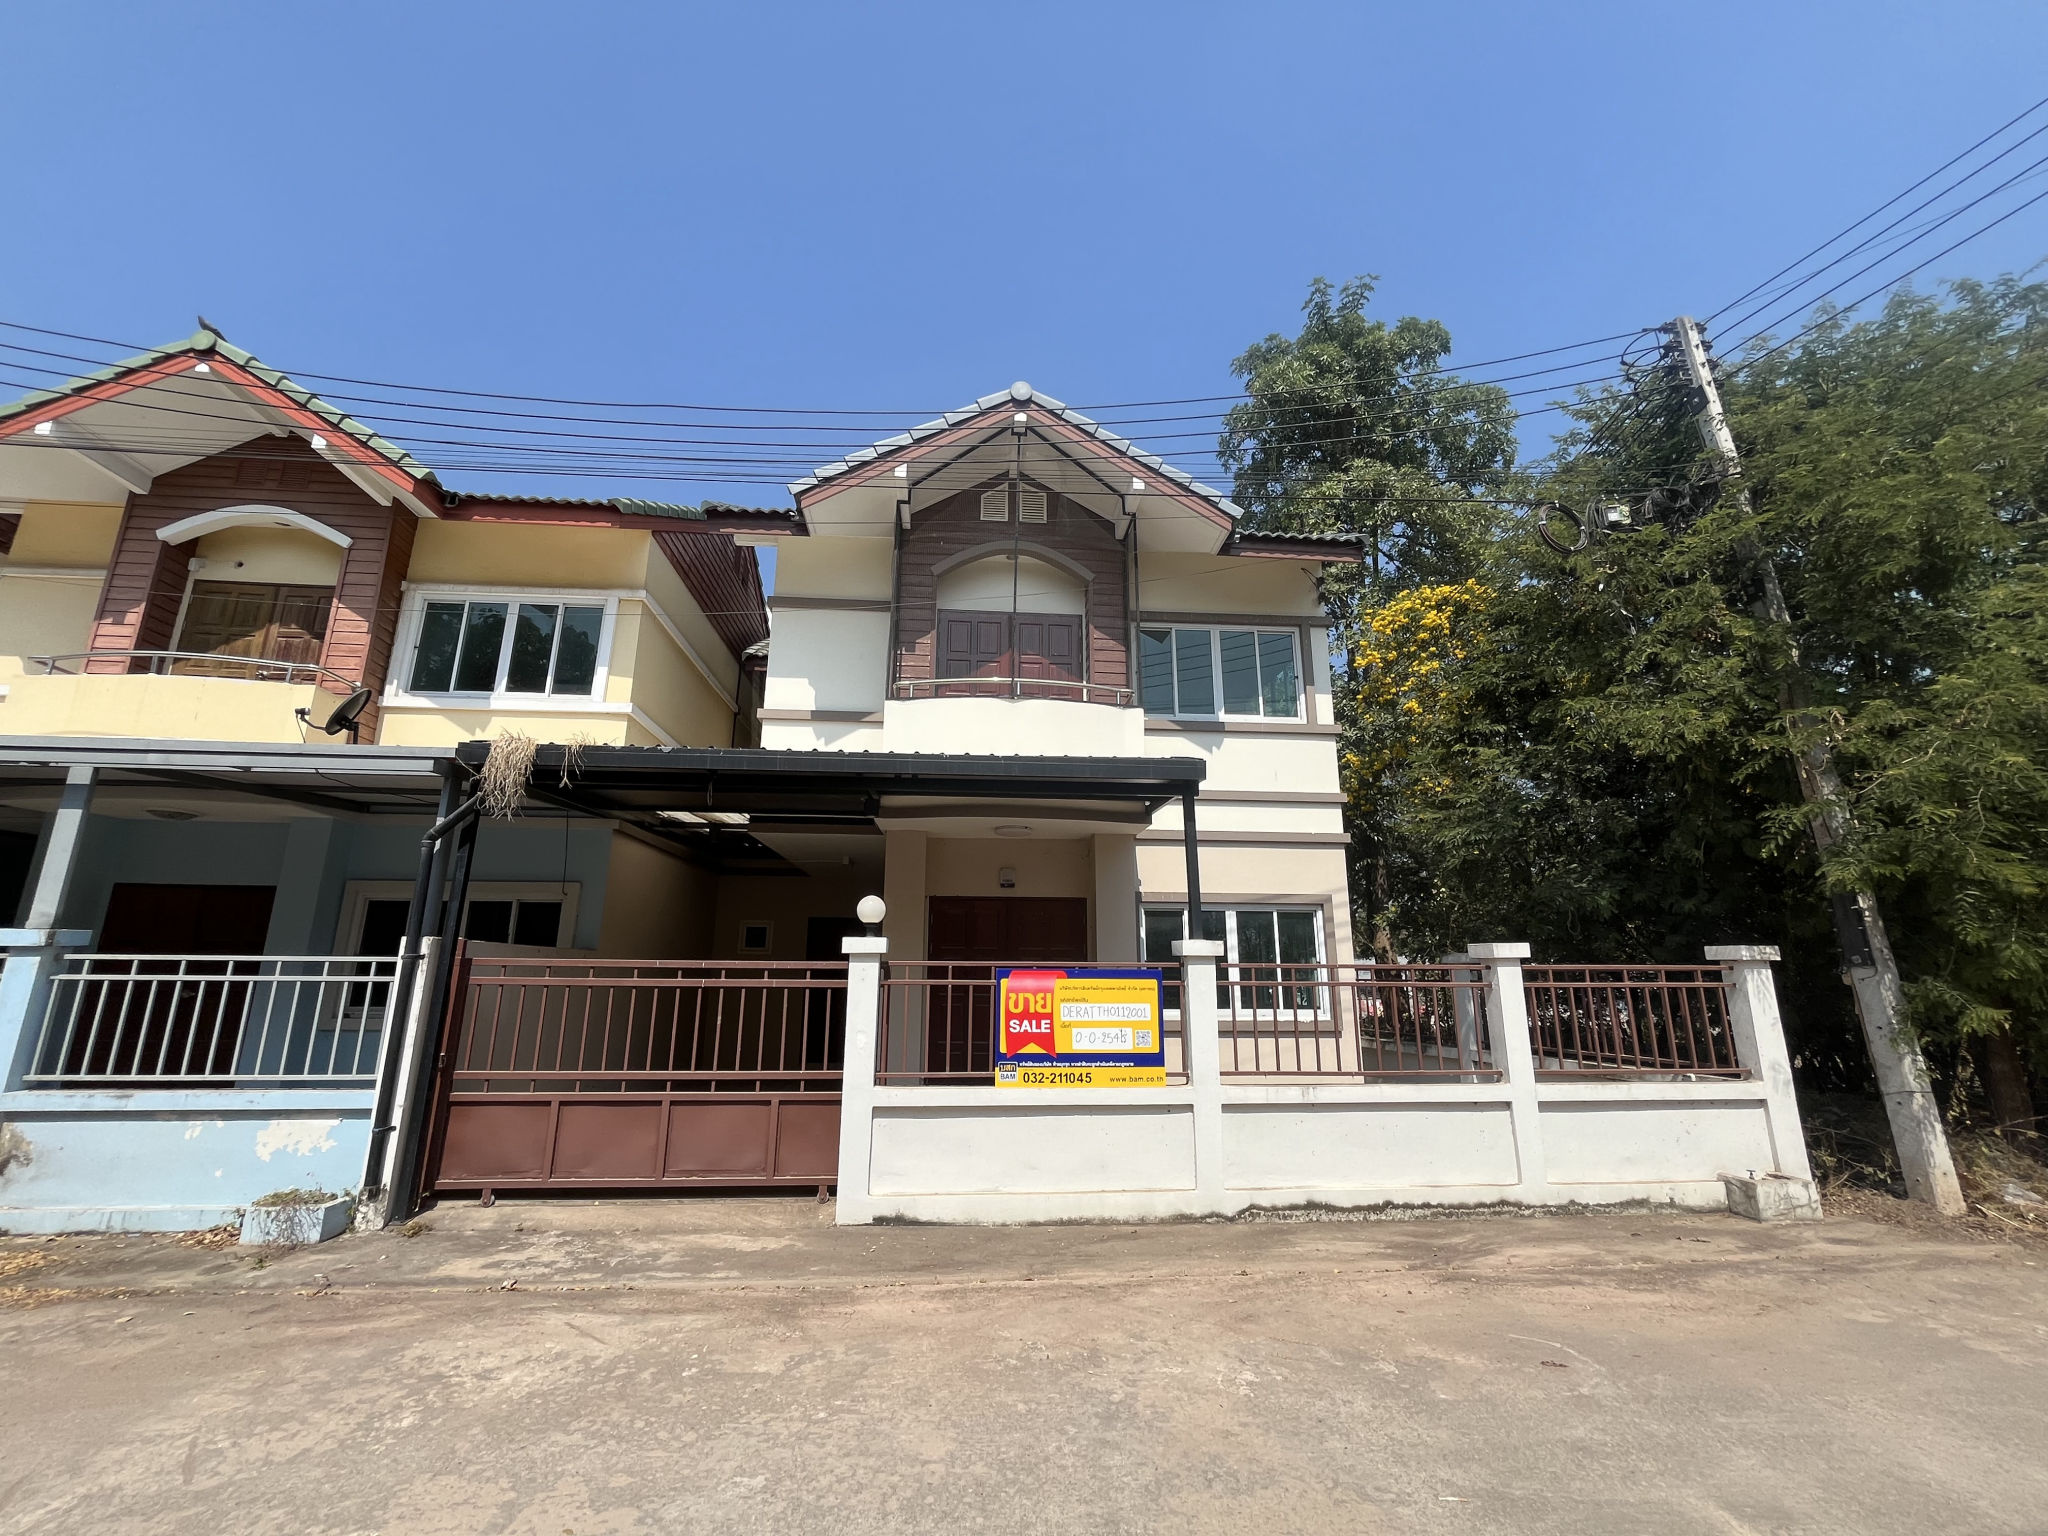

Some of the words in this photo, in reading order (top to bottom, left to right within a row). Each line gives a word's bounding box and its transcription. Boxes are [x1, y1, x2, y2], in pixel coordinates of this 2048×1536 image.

[1009, 992, 1052, 1014] ขาย
[1009, 1019, 1051, 1033] SALE
[1023, 1072, 1092, 1083] 032-211045
